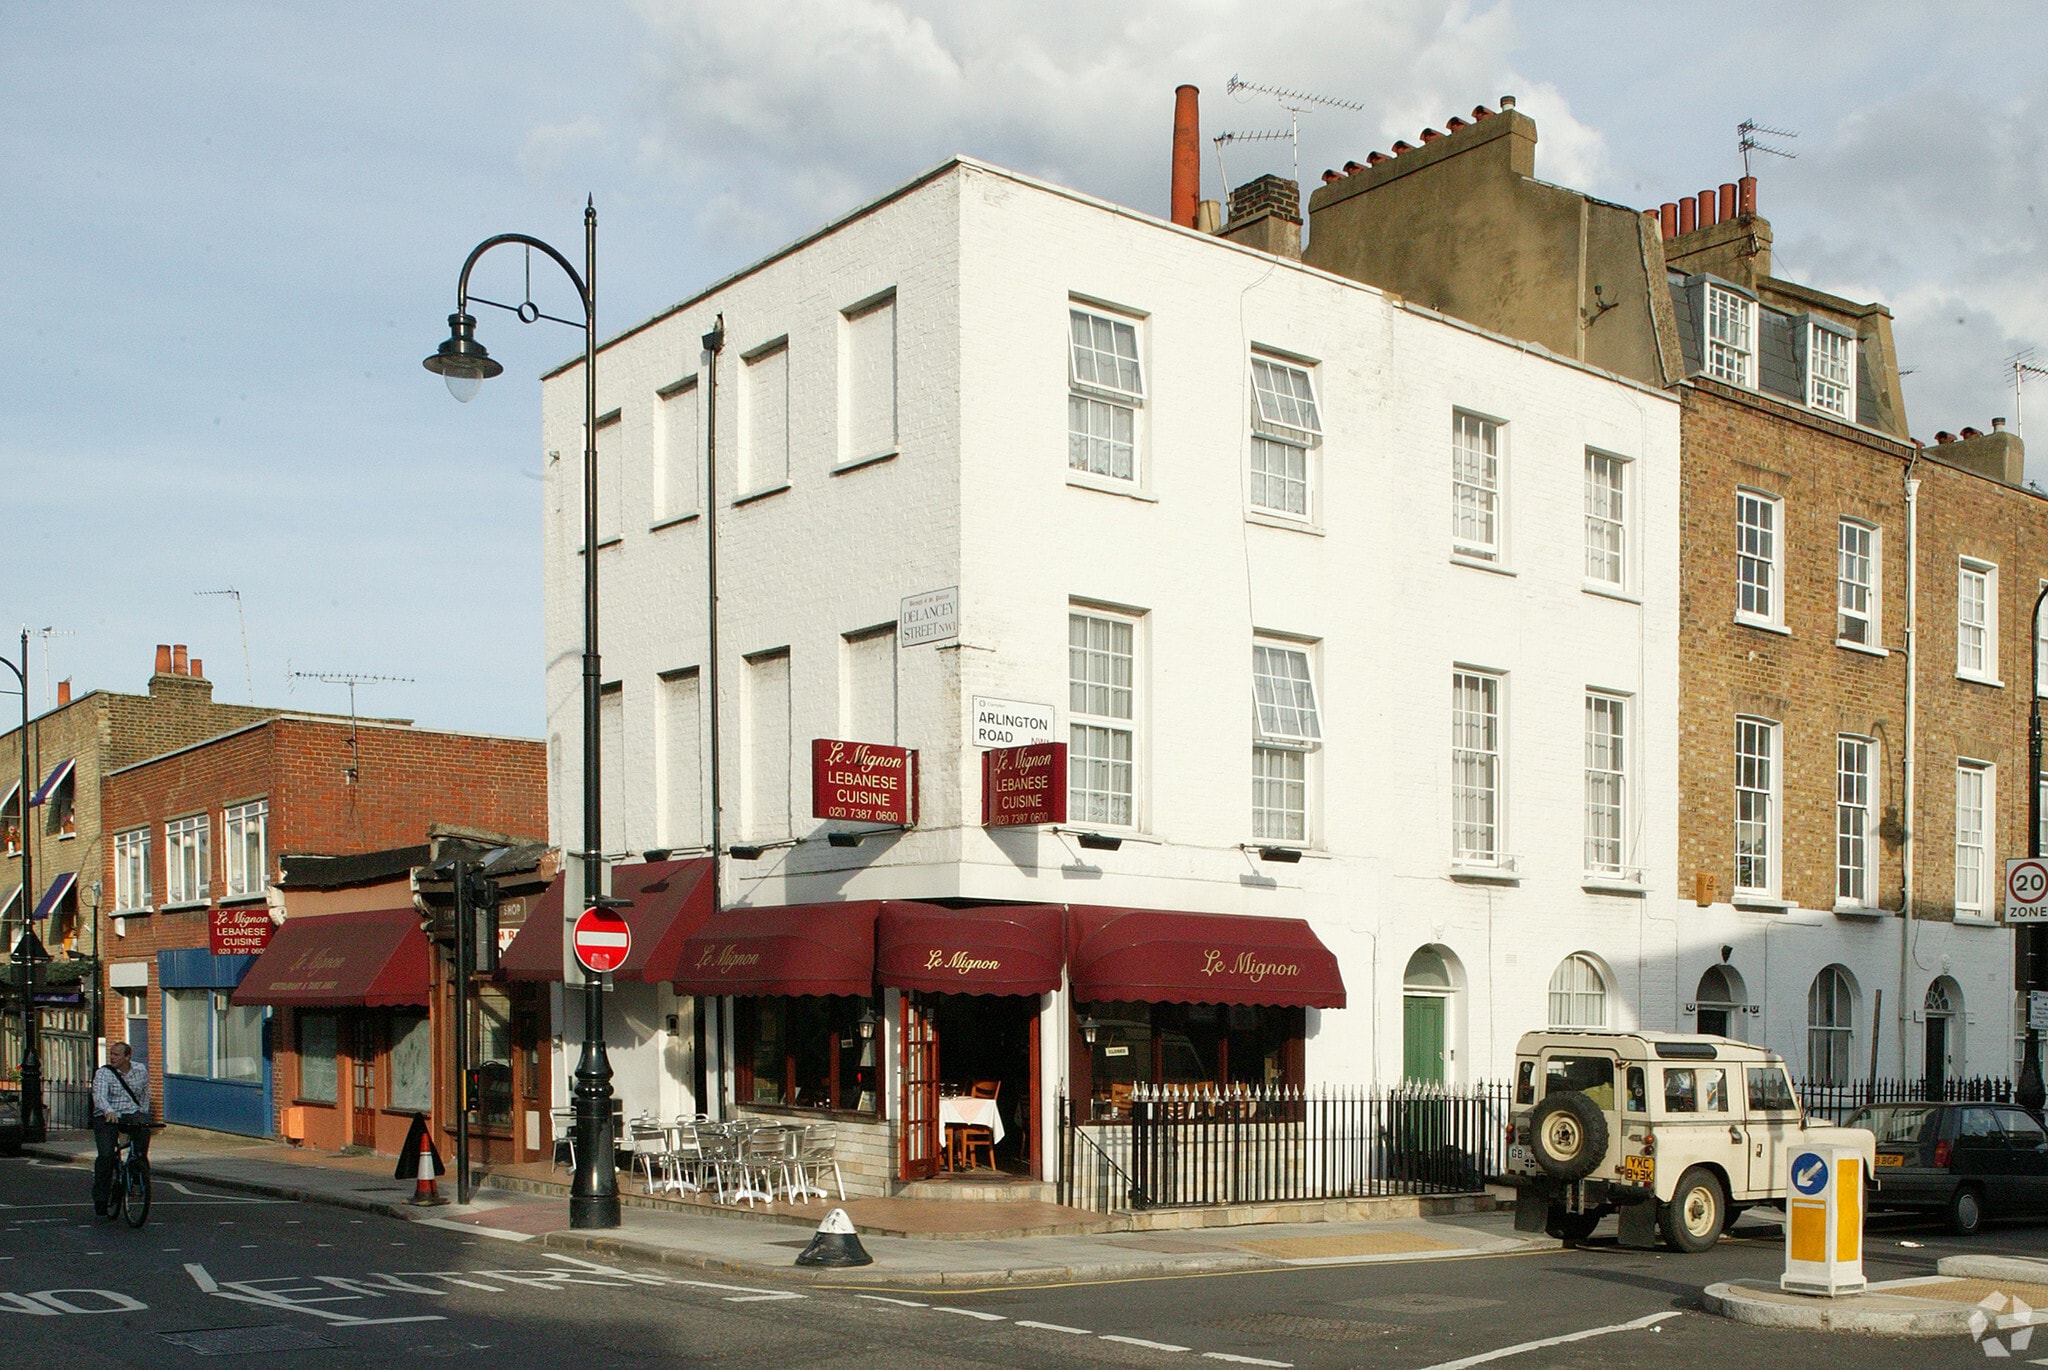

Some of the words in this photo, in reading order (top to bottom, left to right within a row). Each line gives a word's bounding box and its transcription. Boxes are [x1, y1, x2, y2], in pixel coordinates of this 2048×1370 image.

[904, 601, 956, 624] DELANCEY
[904, 622, 939, 640] STREET
[939, 621, 956, 633] NW1
[978, 712, 1048, 730] ARLINGTON
[978, 728, 1014, 743] ROAD
[825, 742, 845, 766] Le
[846, 745, 903, 773] Mignon
[994, 749, 1008, 774] Le
[1009, 747, 1052, 776] Mignon
[828, 771, 898, 790] LEBANESE
[996, 775, 1048, 792] LEBANESE
[836, 789, 891, 807] CUISINE
[1002, 794, 1042, 809] CUISINE
[828, 806, 847, 818] 020
[850, 808, 872, 819] 7387
[876, 811, 898, 822] 0600
[997, 815, 1009, 825] 020
[1011, 813, 1028, 824] 7387
[1030, 812, 1049, 823] 0600
[2016, 874, 2044, 891] 20
[503, 903, 521, 916] SHOP
[2010, 906, 2048, 918] ZONE
[214, 911, 228, 926] Le
[228, 911, 269, 928] Mignon
[216, 927, 267, 936] LEBANESE
[223, 937, 262, 946] CUISINE
[695, 944, 715, 969] Le
[711, 944, 760, 974] Mignon
[923, 949, 944, 971] Le
[944, 951, 1001, 975] Mignon
[1200, 949, 1226, 977] Le
[1229, 951, 1300, 983] Mignon
[1511, 1148, 1523, 1159] GB
[1630, 1157, 1650, 1169] YXC
[1626, 1168, 1653, 1181] 843K
[218, 1253, 667, 1304] ENTRY
